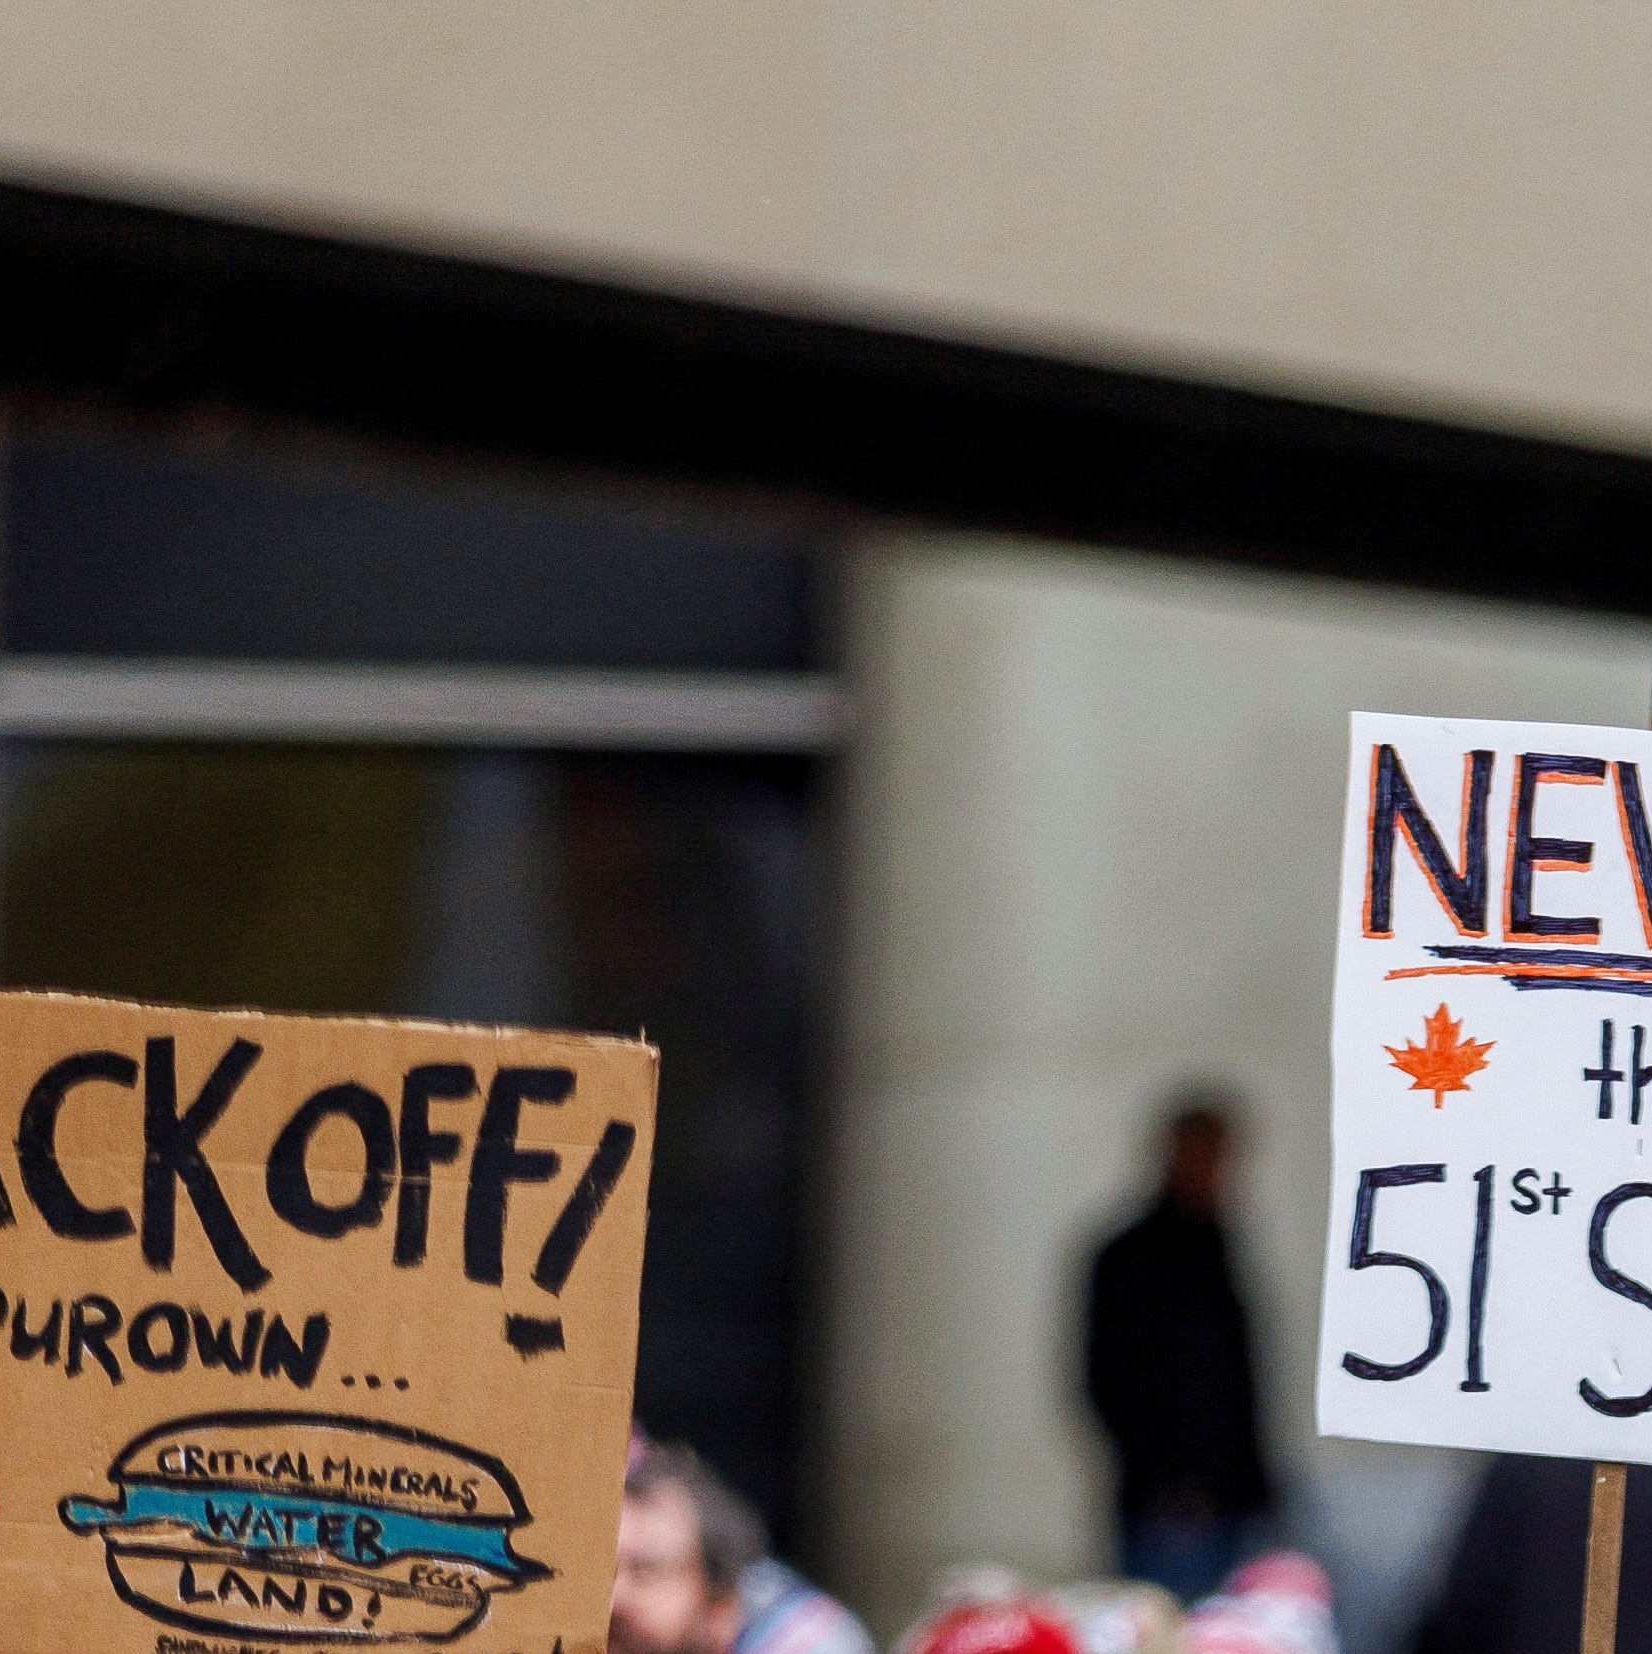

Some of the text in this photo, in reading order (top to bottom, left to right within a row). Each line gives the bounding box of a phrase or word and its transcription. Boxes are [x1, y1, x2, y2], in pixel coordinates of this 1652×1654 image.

[1342, 1164, 1574, 1393] 51st
[157, 1444, 479, 1511] CRITICAL MINERALS
[205, 1500, 386, 1564] WATER
[180, 1561, 383, 1629] LAND!
